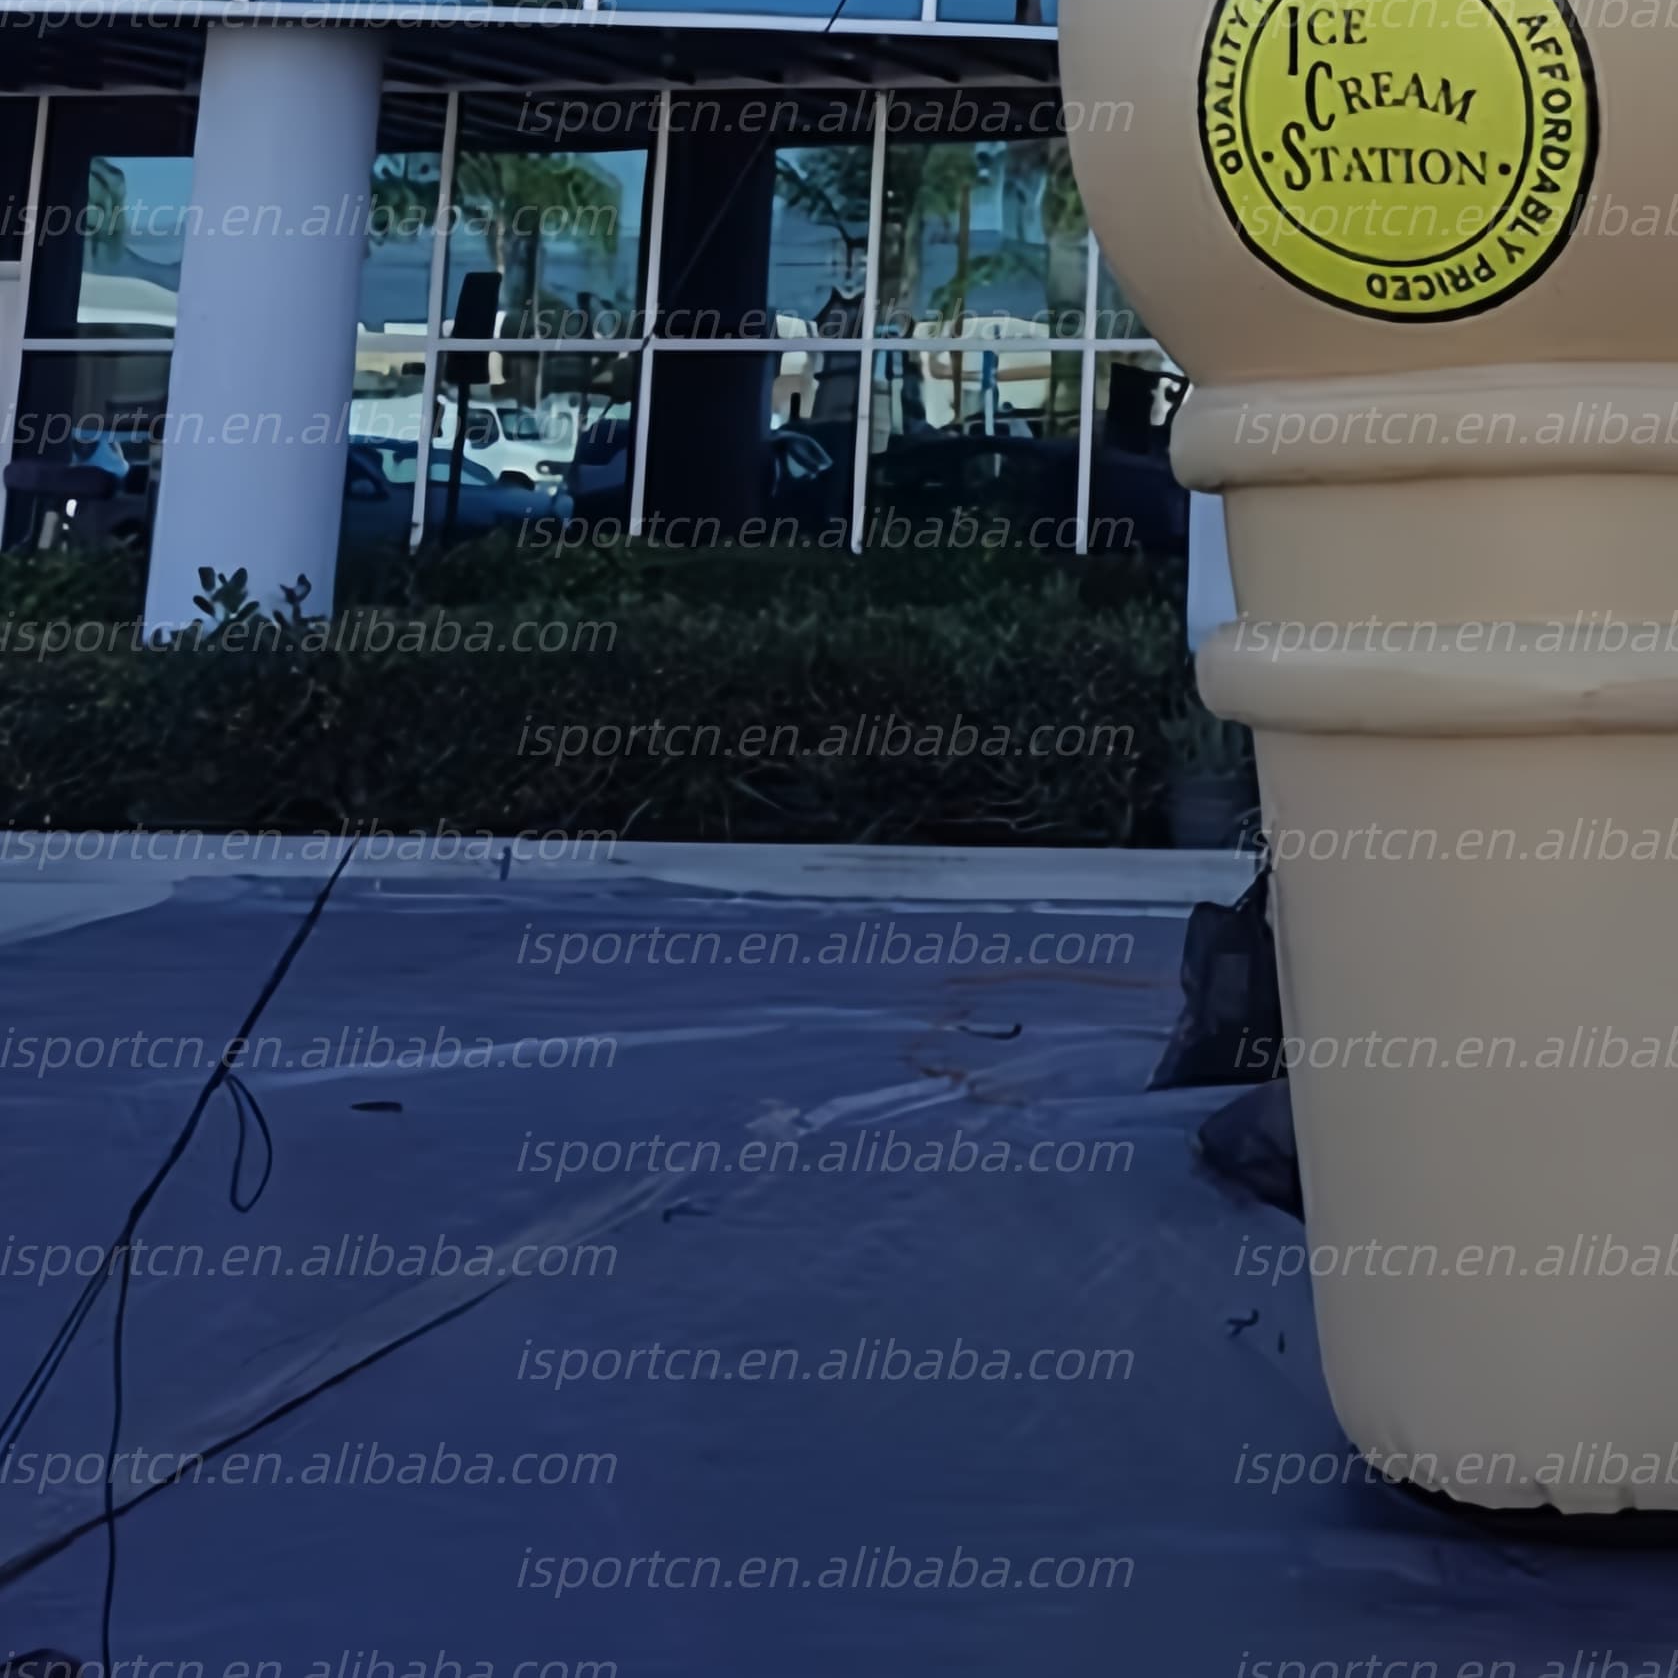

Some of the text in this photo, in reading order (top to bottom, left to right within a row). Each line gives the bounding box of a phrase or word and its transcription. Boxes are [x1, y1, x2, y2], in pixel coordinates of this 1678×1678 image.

[1288, 5, 1368, 76] ICE
[1212, 5, 1250, 175] QUALITY
[1305, 60, 1477, 132] CREAM
[1281, 121, 1489, 191] STATION
[1365, 12, 1574, 301] AFFORDABLY PRICED
